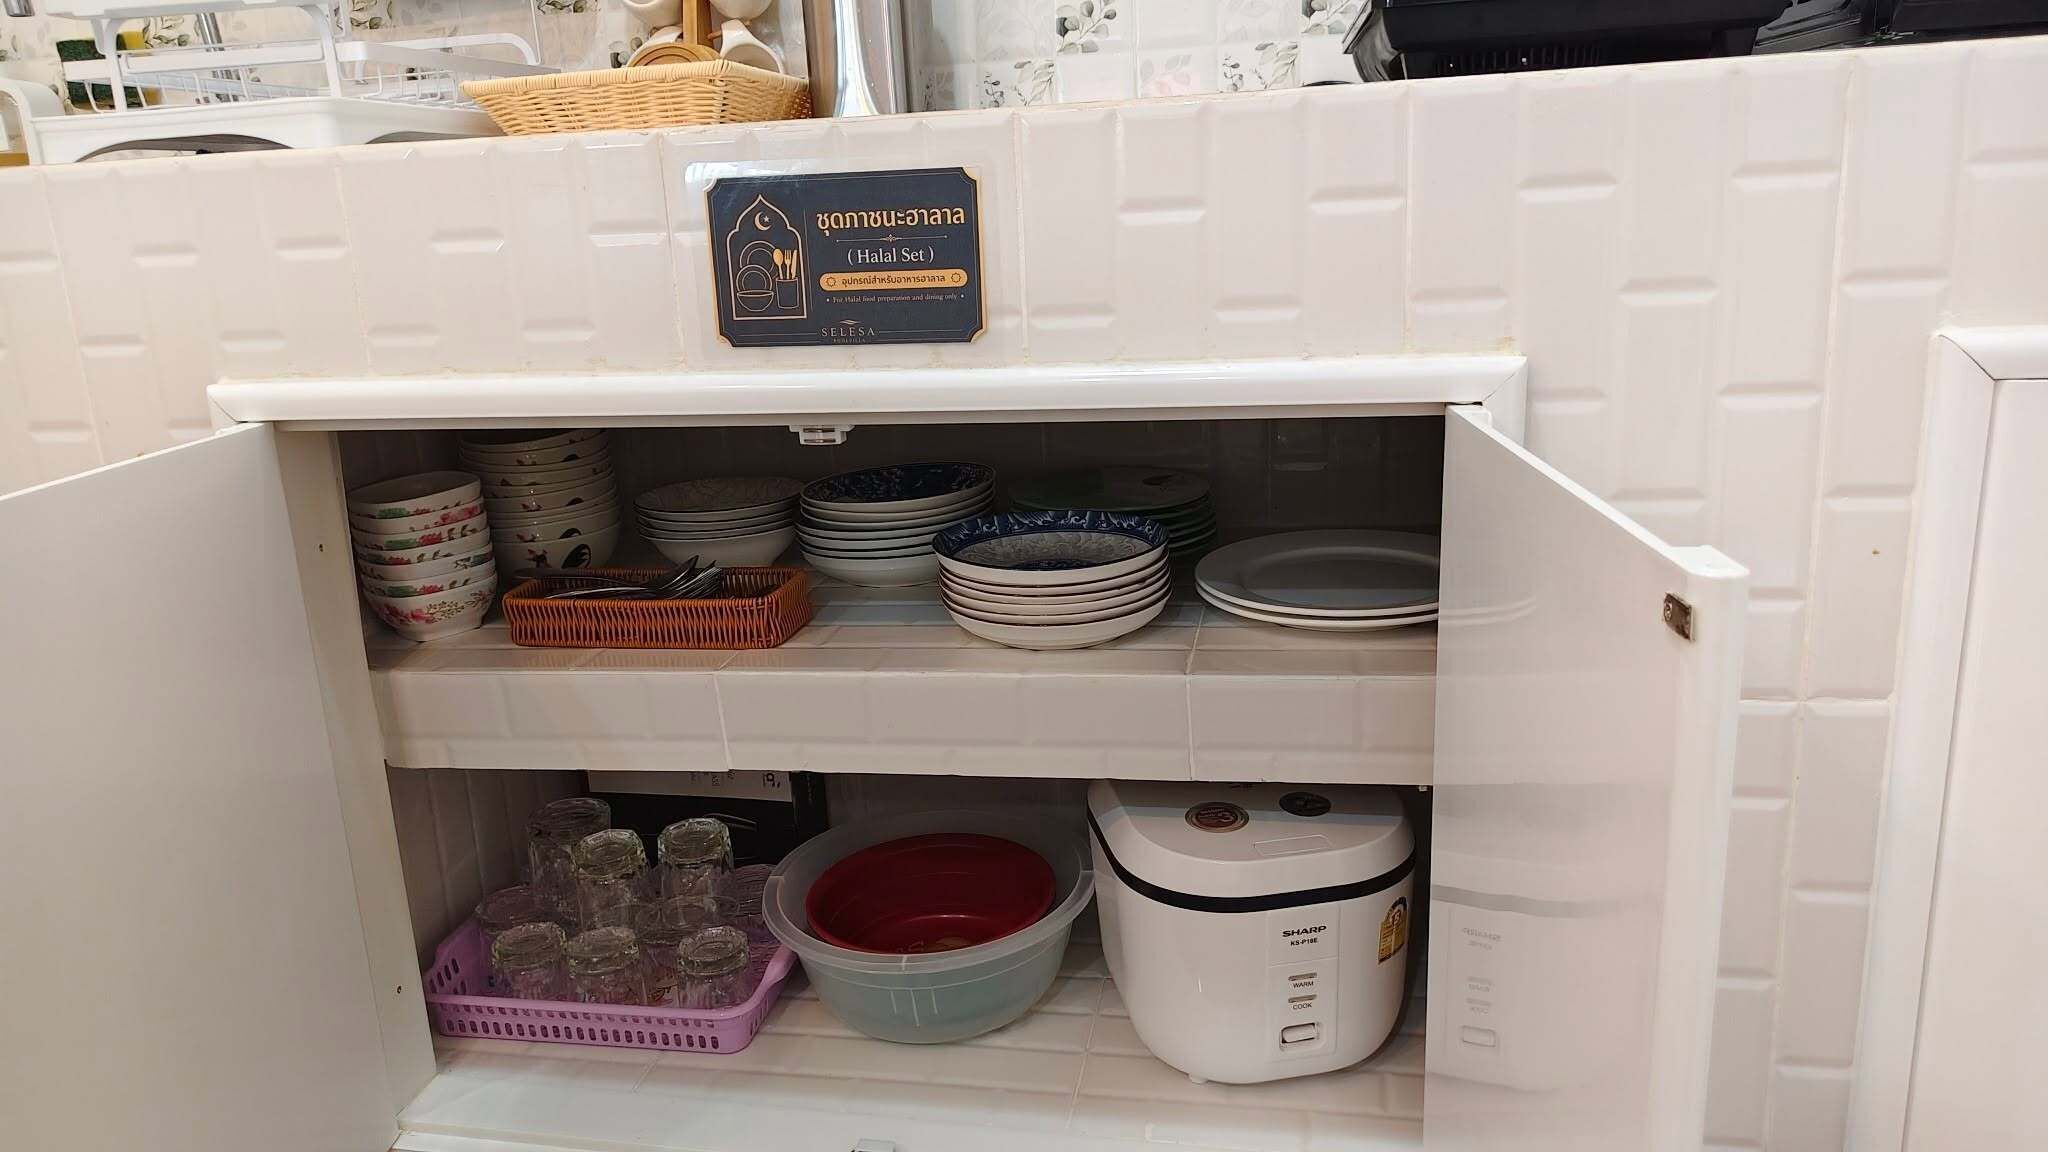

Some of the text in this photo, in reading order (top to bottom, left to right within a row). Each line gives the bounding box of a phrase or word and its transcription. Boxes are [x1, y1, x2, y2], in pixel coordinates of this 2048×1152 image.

[816, 207, 966, 237] ชุดภาชนะฮาลาล
[857, 247, 897, 264] Halal
[901, 247, 925, 262] Set
[841, 275, 946, 288] อุปกรณ์สำหรับอาหารฮาลาล
[877, 295, 911, 303] preparation
[924, 293, 943, 301] dining
[821, 327, 875, 337] SELESA
[1282, 925, 1327, 938] SHARP
[1293, 980, 1314, 989] WARM
[1292, 1002, 1313, 1010] COOK
